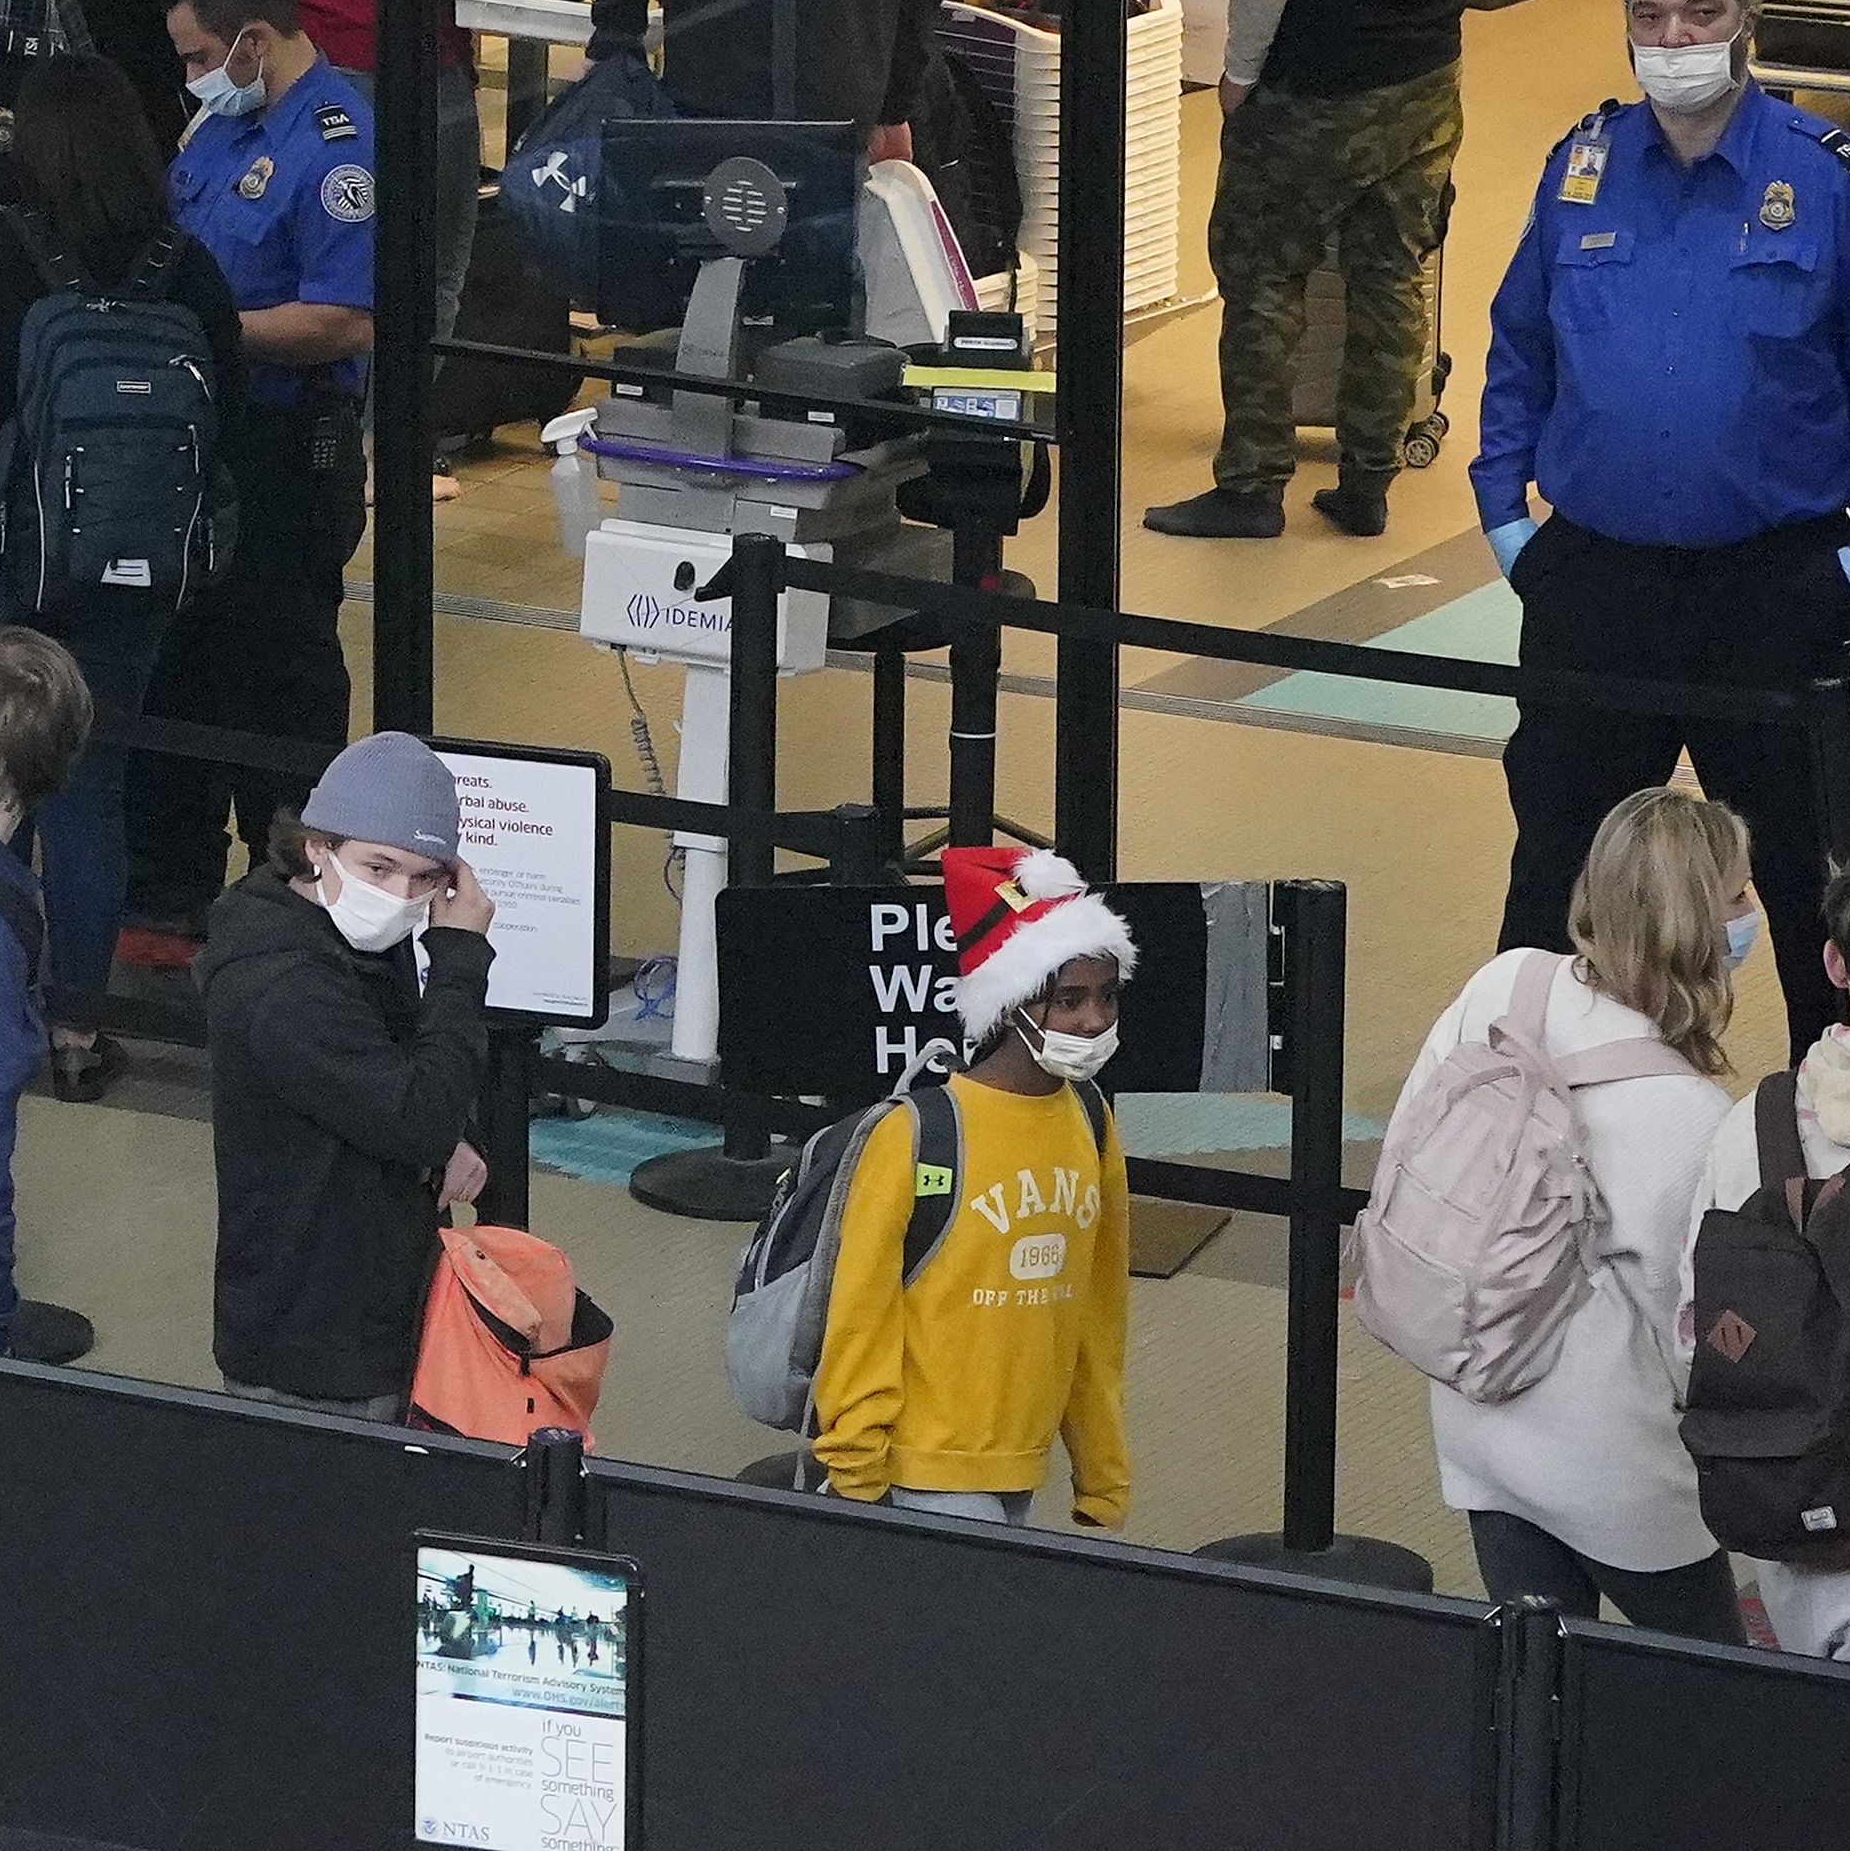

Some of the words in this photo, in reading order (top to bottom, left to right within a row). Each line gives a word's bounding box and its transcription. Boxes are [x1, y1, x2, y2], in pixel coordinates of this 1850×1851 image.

[488, 797, 528, 812] abuse.
[466, 831, 497, 846] kind.
[499, 819, 552, 835] violence
[869, 902, 959, 953] Ple
[867, 963, 962, 1014] Wa
[969, 1166, 1100, 1235] VANS
[1020, 1243, 1061, 1269] 1966
[972, 1288, 1009, 1307] OFF
[1015, 1287, 1049, 1306] THE
[417, 1660, 443, 1671] NTAS:
[447, 1664, 489, 1677] National
[492, 1670, 538, 1684] Terrorism
[542, 1676, 586, 1692] Advisory
[589, 1682, 626, 1696] System
[542, 1718, 552, 1733] if
[555, 1722, 581, 1739] you
[540, 1734, 614, 1785] SEE
[541, 1776, 614, 1803] something
[540, 1792, 617, 1843] SAY
[442, 1821, 489, 1841] NTAS
